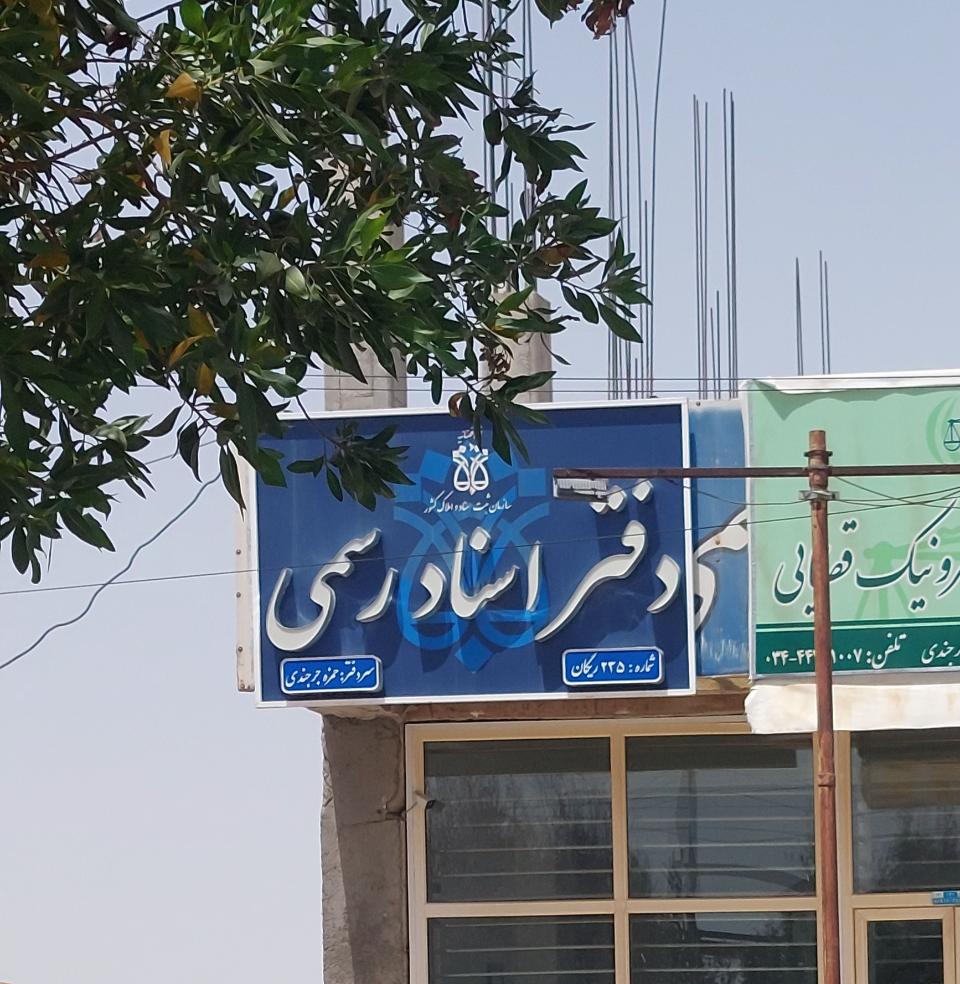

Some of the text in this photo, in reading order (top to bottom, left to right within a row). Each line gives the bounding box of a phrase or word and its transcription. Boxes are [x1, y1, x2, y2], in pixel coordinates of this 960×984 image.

[265, 527, 398, 652] رسمی
[412, 527, 541, 620] اسناد
[535, 478, 681, 643] دفتر
[323, 667, 339, 686] حمزه
[571, 652, 599, 678] ریگان
